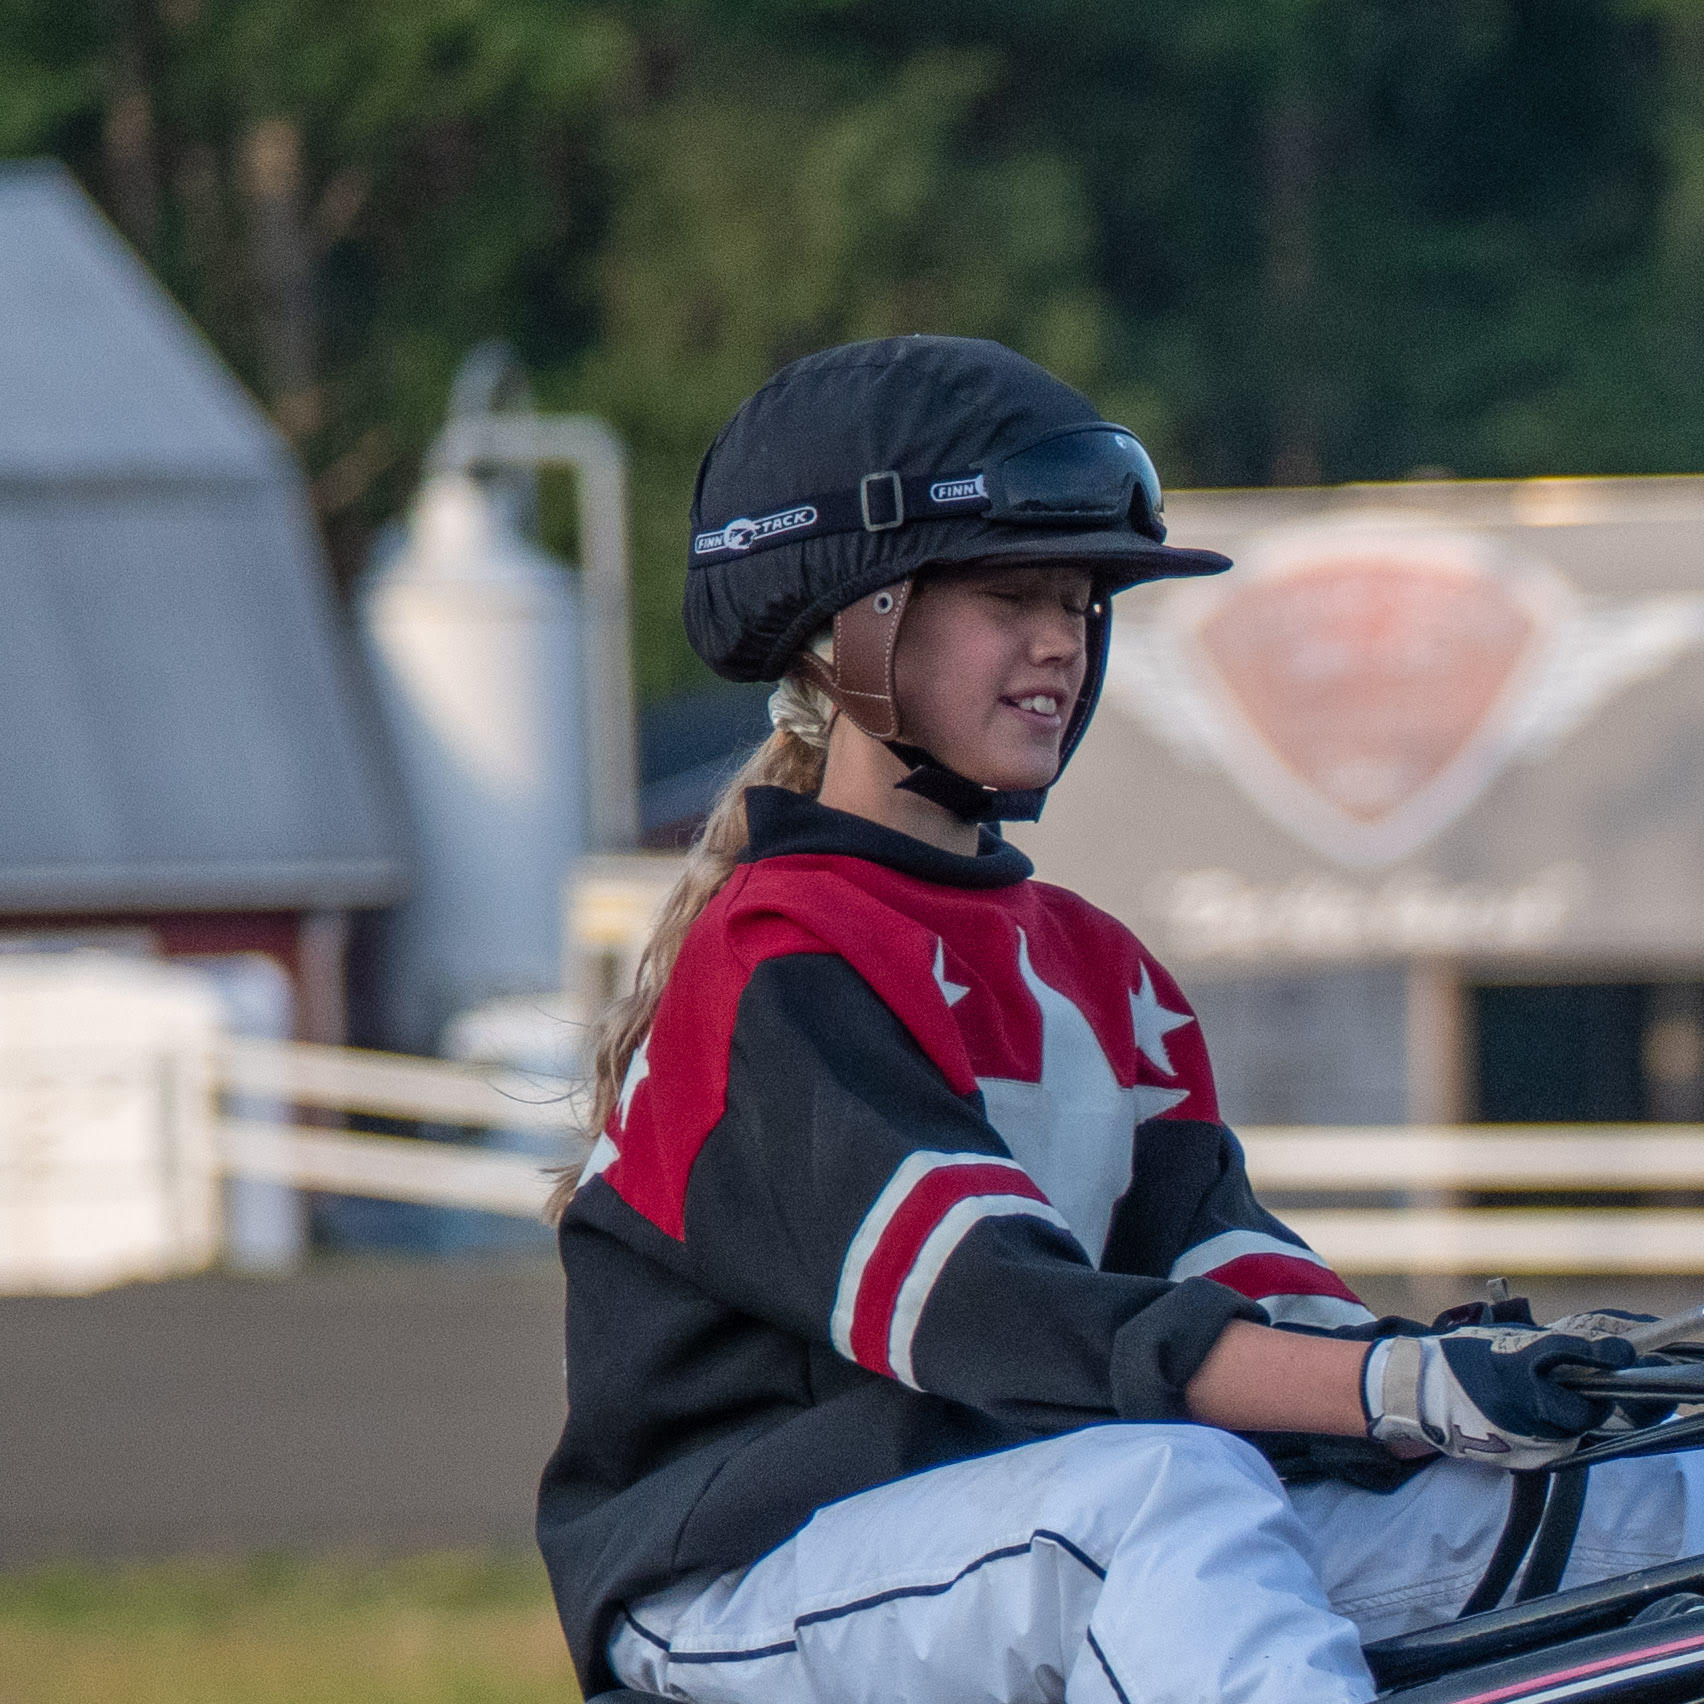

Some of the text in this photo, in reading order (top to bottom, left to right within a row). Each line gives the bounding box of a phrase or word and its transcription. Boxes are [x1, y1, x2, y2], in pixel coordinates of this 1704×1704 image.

[938, 483, 975, 498] FINN
[698, 512, 808, 549] FINN TACK
